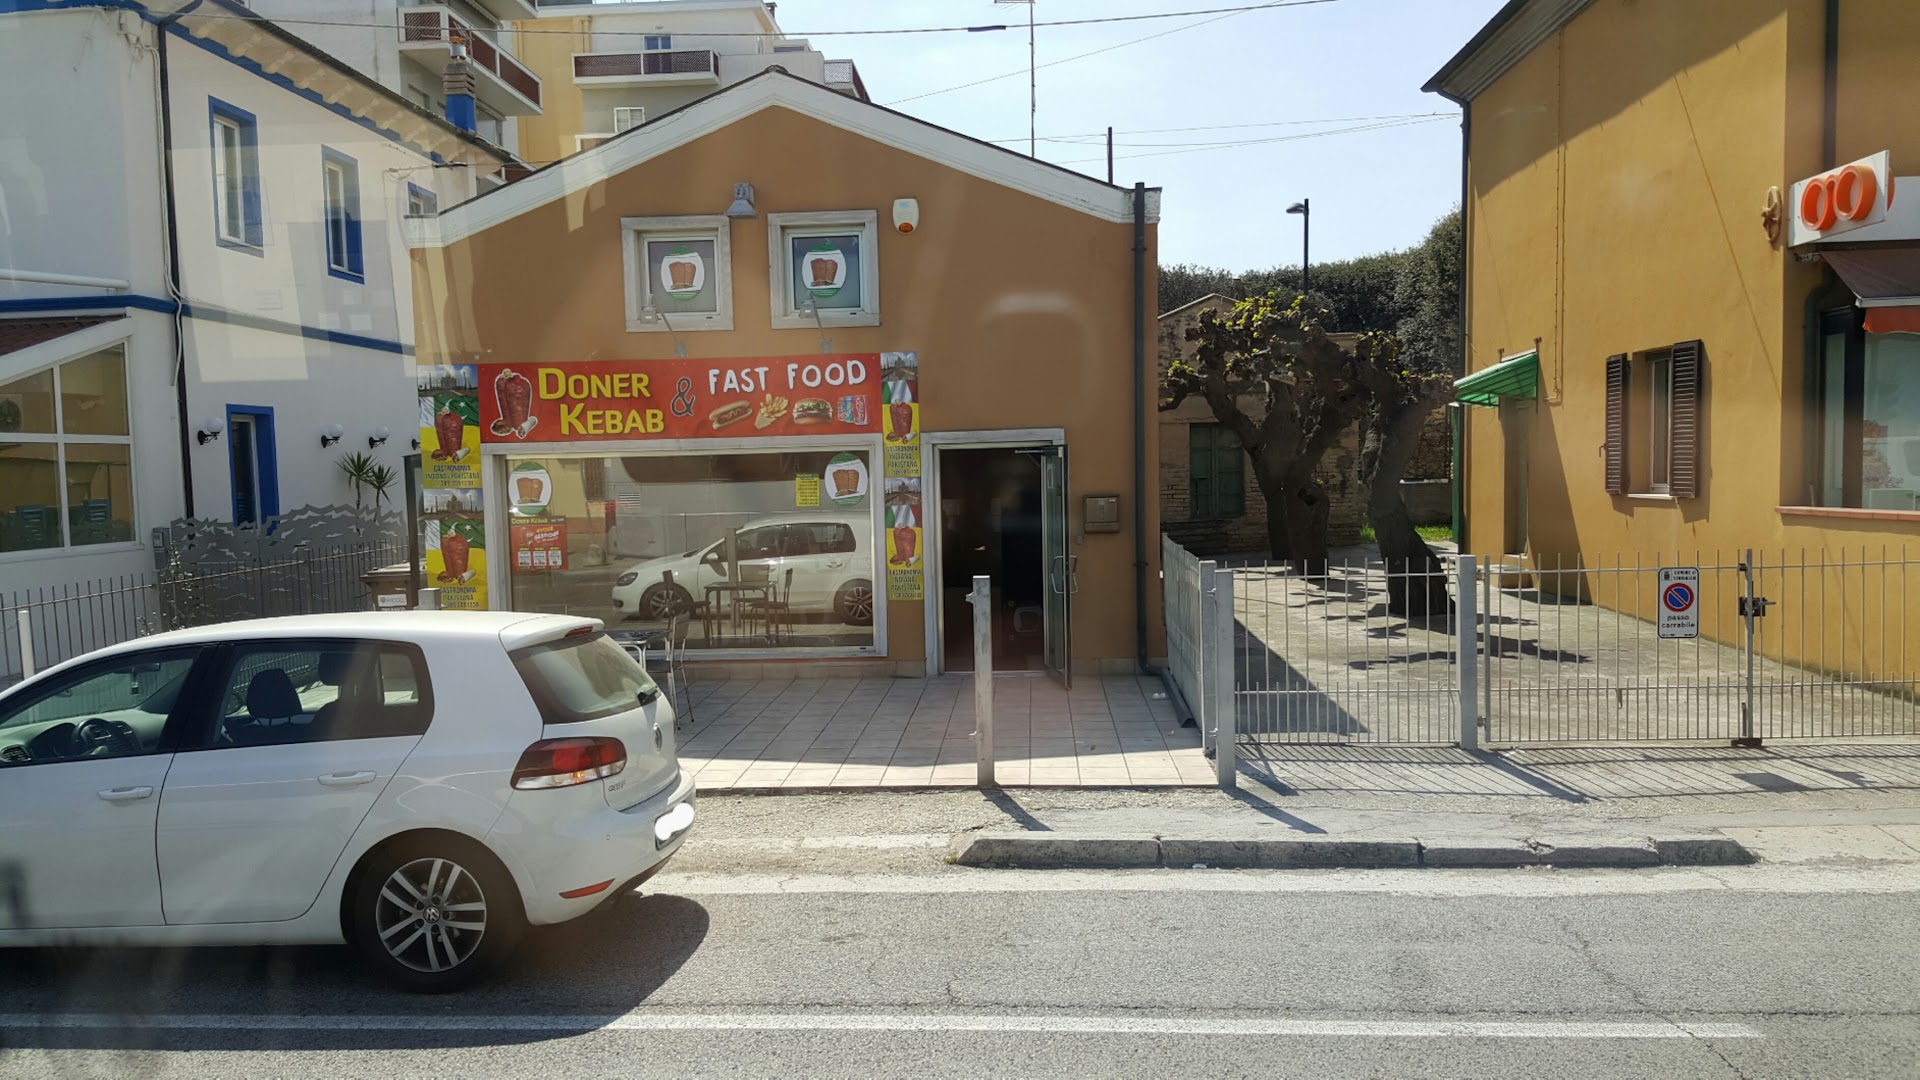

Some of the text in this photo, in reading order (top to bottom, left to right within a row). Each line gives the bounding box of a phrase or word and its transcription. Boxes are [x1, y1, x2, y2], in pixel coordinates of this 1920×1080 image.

[538, 368, 651, 400] DONER
[708, 360, 867, 395] FAST FOOD
[670, 376, 696, 417] &
[560, 403, 664, 435] KEBAB
